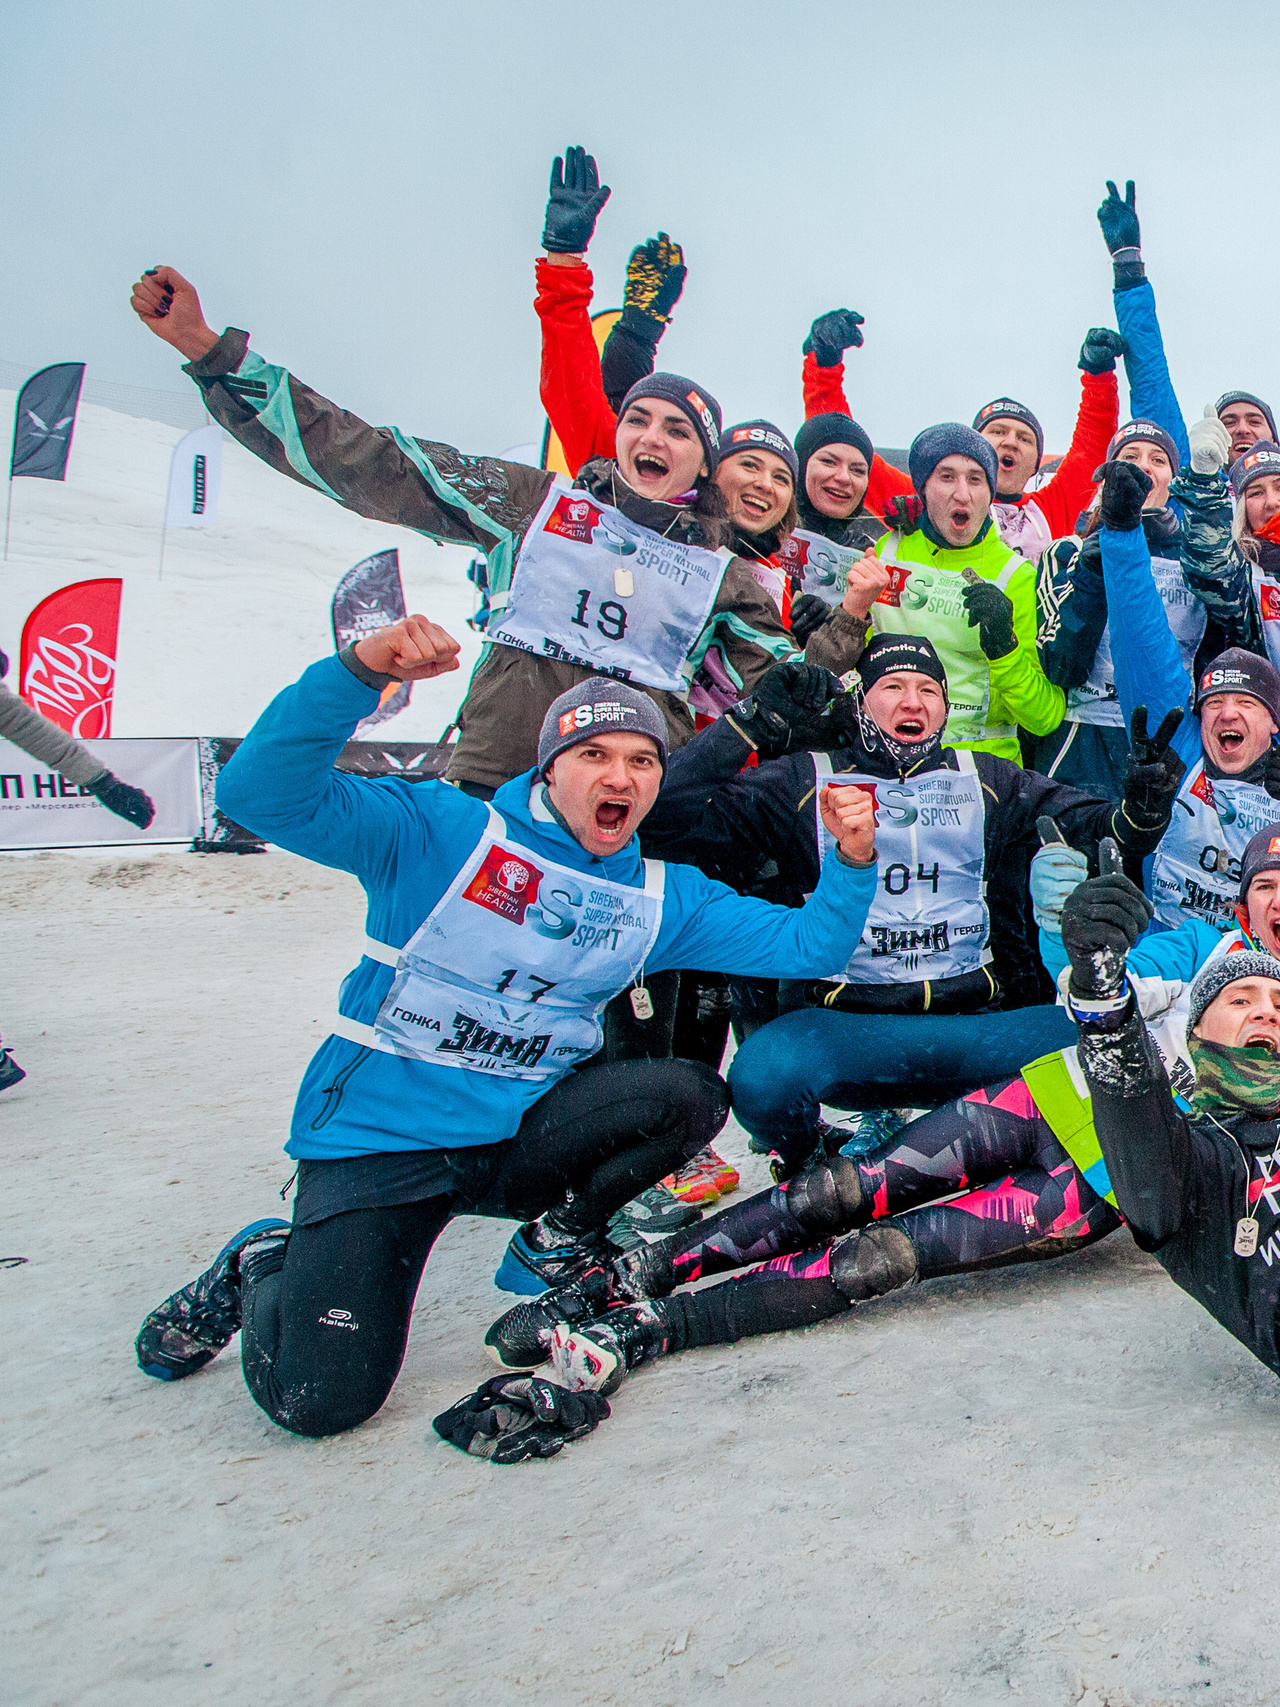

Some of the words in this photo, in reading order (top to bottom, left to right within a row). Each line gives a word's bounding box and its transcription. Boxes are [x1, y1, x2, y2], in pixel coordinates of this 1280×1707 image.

[553, 524, 586, 538] HEALTH
[635, 548, 693, 587] SPORT
[642, 539, 675, 561] SUPER
[673, 552, 712, 583] NATURAL
[932, 586, 957, 597] SUPER
[570, 589, 629, 641] 19
[870, 643, 917, 662] helvetia
[593, 712, 626, 723] SPORT
[948, 702, 983, 712] ГЕРОЕВ
[920, 807, 962, 827] SPORT
[882, 862, 940, 896] 04
[1156, 878, 1182, 894] ГОНКА
[476, 890, 520, 916] HEALTH
[487, 884, 519, 905] SIBERIAN
[588, 890, 625, 911] SIBERIAN
[583, 906, 614, 925] SUPER
[571, 924, 624, 951] SPORT
[870, 920, 950, 958] ЗИМА
[953, 923, 985, 936] ГЕРОЕВ
[495, 969, 560, 1003] 17
[390, 1006, 442, 1033] ГОНКА
[434, 1011, 554, 1069] ЗИМА
[318, 1316, 359, 1331] Kalenji
